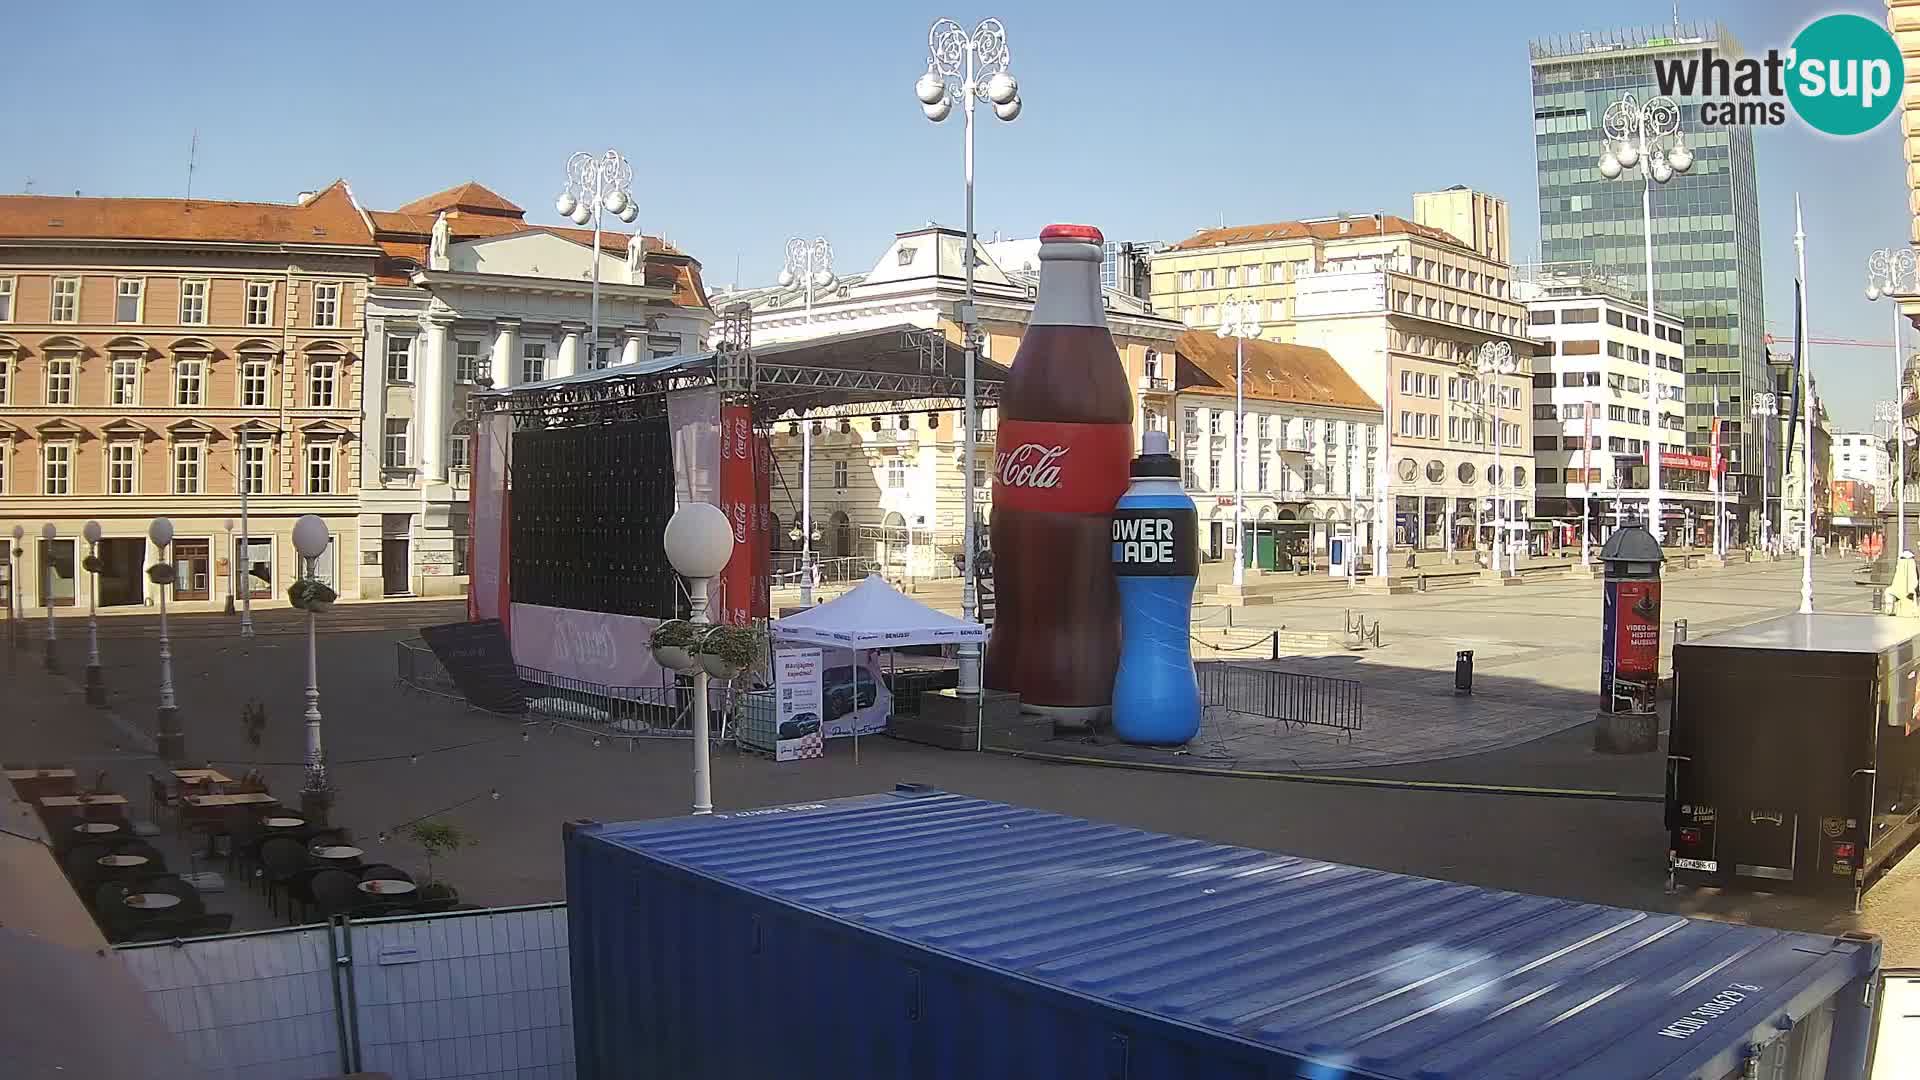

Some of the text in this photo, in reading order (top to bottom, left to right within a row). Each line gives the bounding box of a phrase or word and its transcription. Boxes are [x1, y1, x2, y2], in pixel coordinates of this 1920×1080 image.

[1112, 518, 1174, 541] OWER
[1625, 624, 1647, 632] VIDEO
[1657, 1016, 1709, 1039] MCDU
[1691, 990, 1747, 1019] 300629
